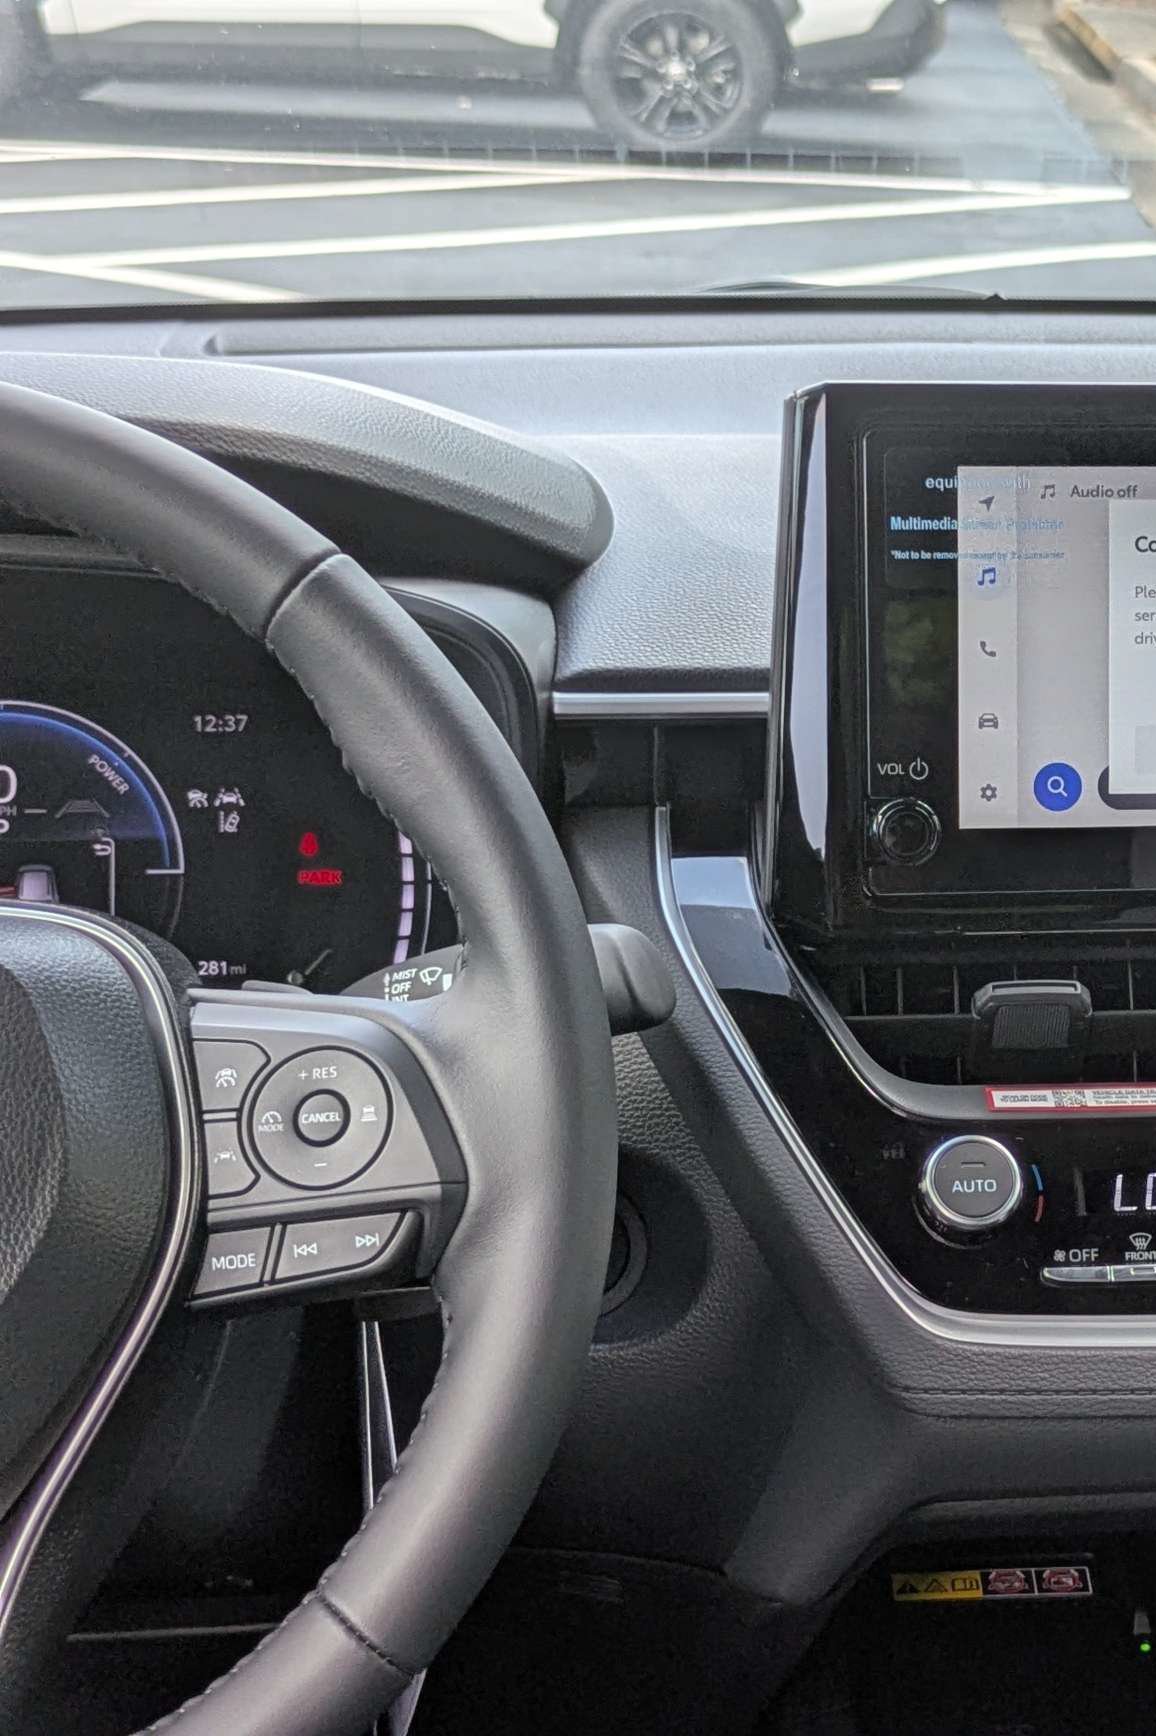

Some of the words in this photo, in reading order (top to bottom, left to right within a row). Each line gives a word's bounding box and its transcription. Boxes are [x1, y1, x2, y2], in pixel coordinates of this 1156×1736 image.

[1070, 484, 1114, 498] Audio
[1117, 484, 1138, 498] off
[890, 515, 957, 531] Multimedia
[911, 549, 919, 560] to
[921, 549, 931, 560] be
[194, 714, 249, 733] 12:37
[88, 753, 130, 795] POWER
[877, 763, 905, 775] VOL
[298, 869, 343, 886] PARK
[198, 960, 228, 977] 281
[392, 967, 418, 981] MIST
[391, 981, 412, 994] OFF
[312, 1066, 337, 1079] RES
[301, 1111, 342, 1124] CANCEL
[258, 1123, 284, 1132] MODE
[952, 1179, 997, 1193] AUTO
[211, 1252, 256, 1270] MODE
[1069, 1248, 1099, 1262] OFF
